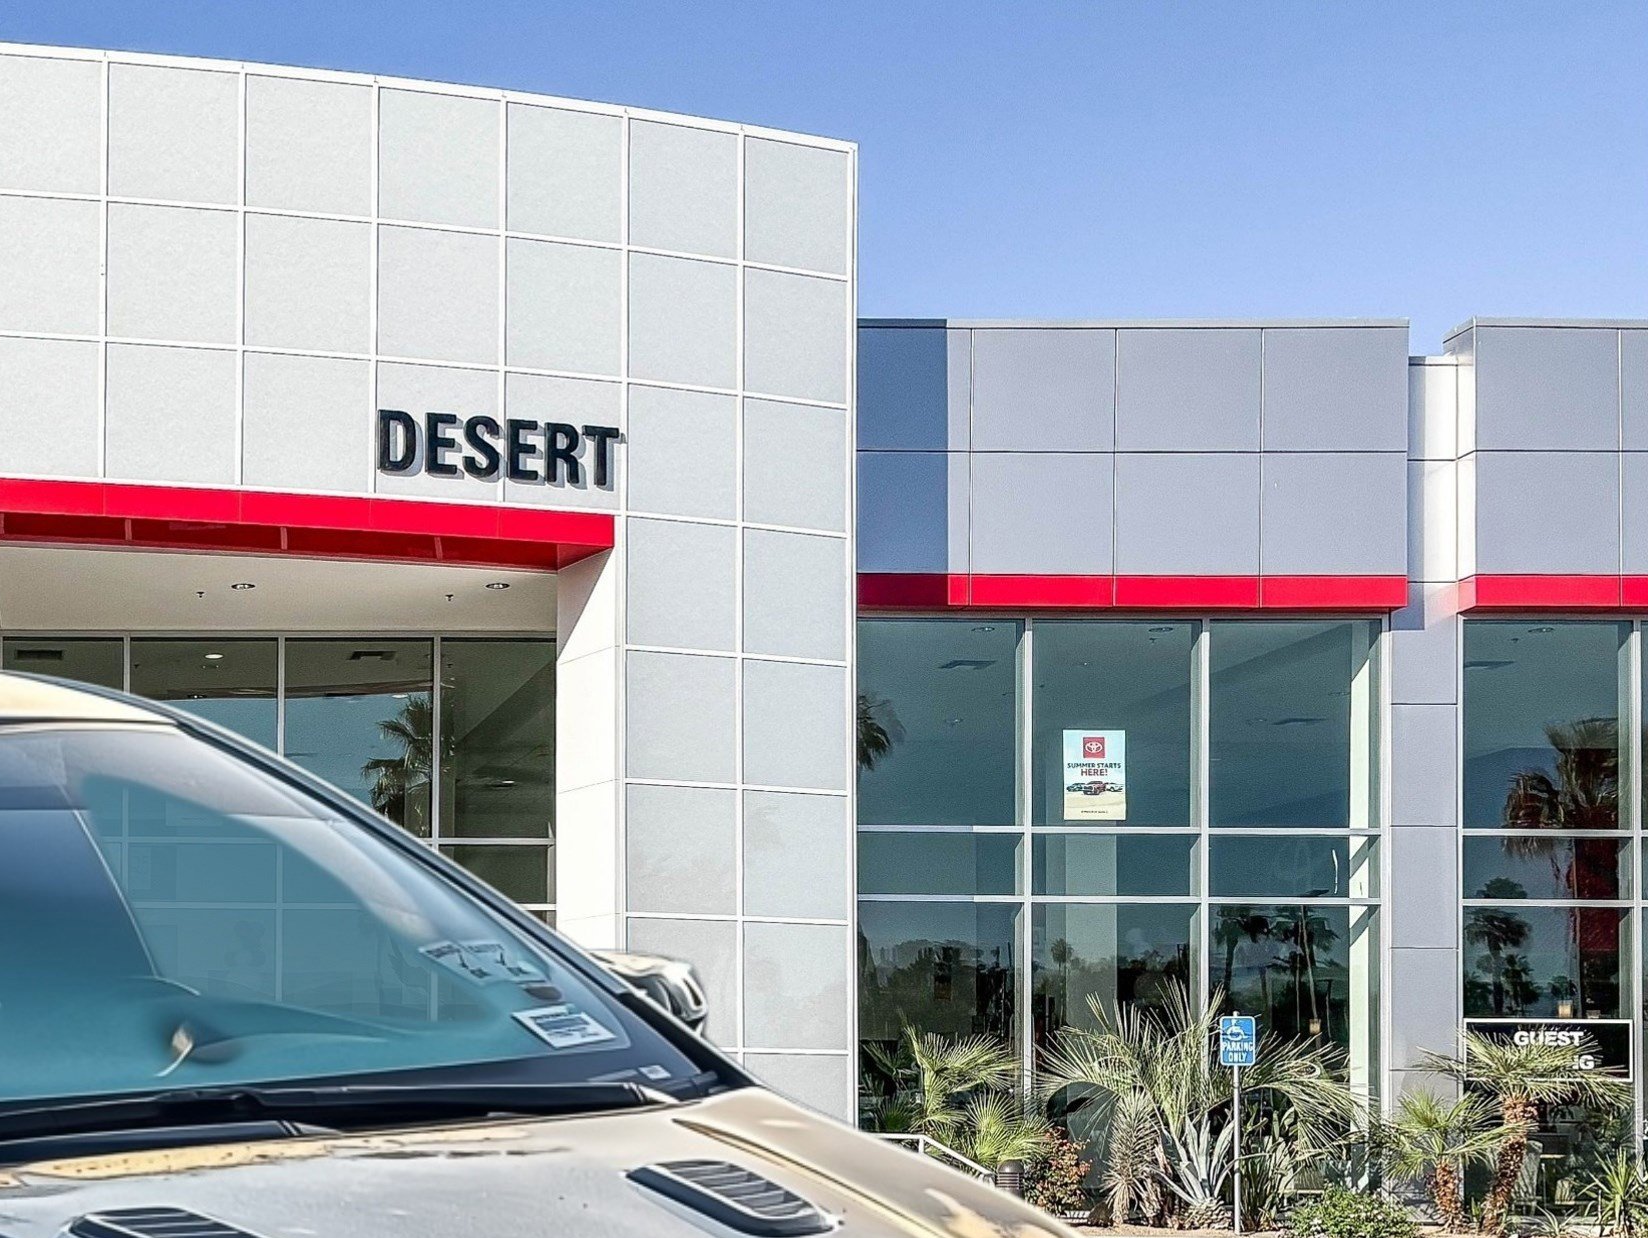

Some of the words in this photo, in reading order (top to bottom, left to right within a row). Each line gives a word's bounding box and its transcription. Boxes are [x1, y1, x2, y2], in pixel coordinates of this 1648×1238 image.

[377, 409, 620, 486] DESERT
[1514, 1031, 1584, 1046] GUEST
[1222, 1041, 1253, 1051] PARKING
[1228, 1052, 1247, 1062] ONLY
